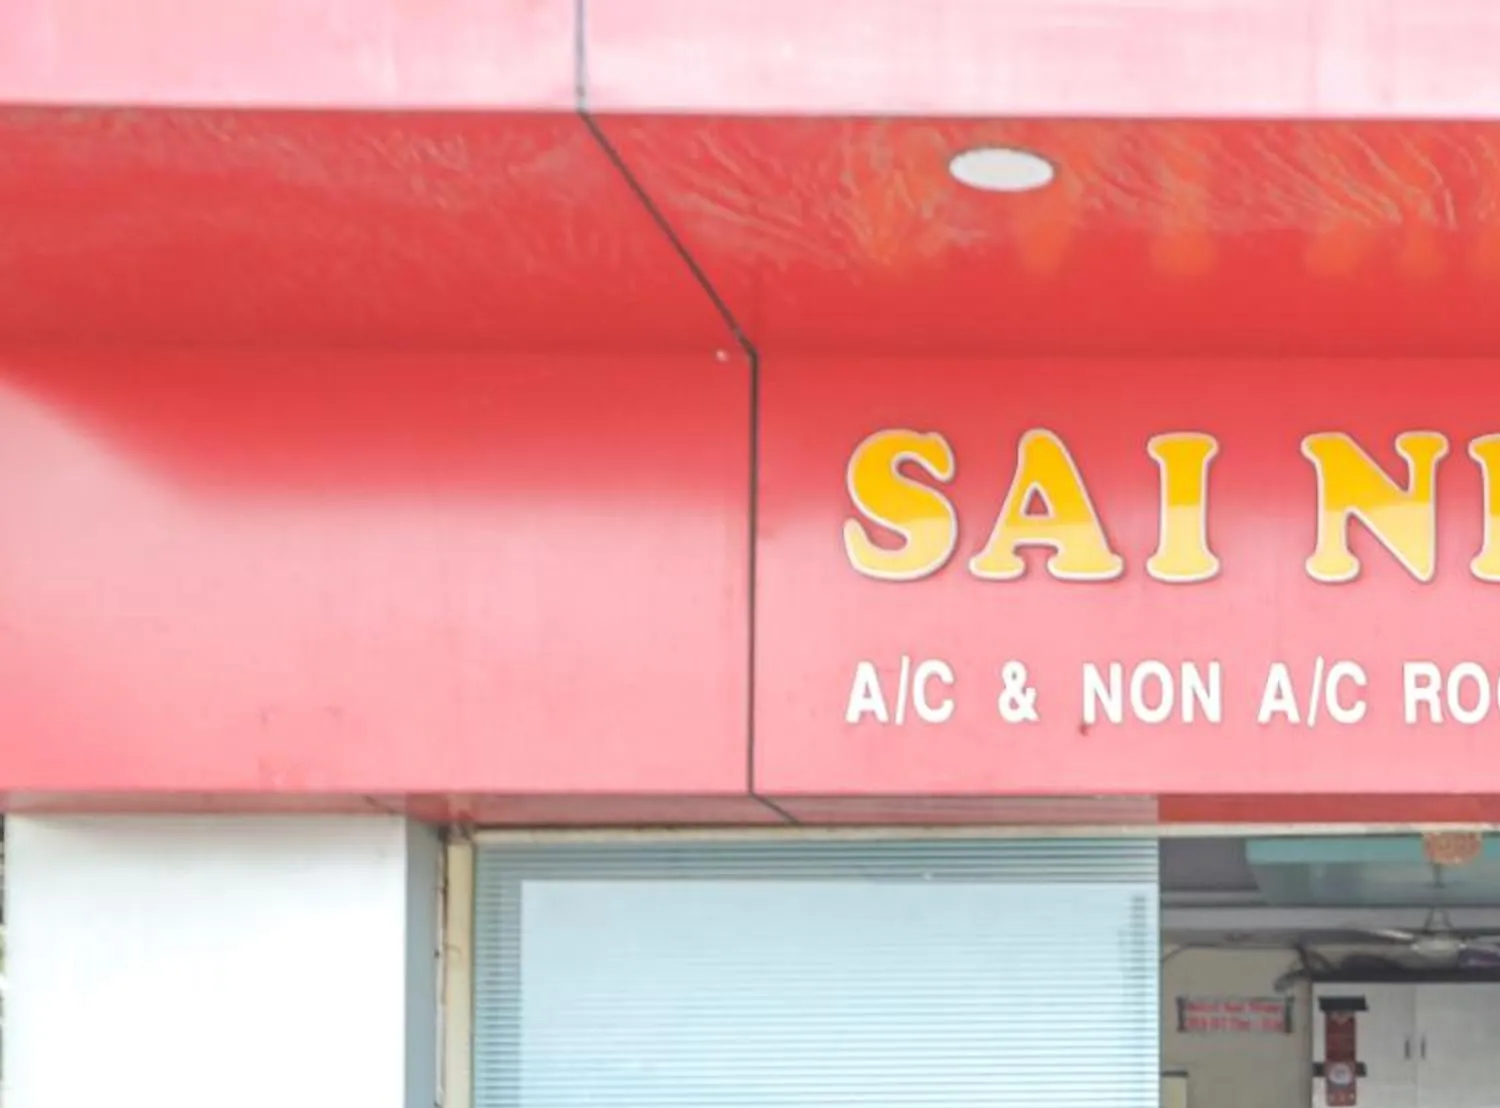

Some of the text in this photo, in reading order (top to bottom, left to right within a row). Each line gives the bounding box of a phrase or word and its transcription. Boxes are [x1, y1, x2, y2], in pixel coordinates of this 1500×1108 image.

[842, 428, 1221, 581] SAI
[845, 655, 954, 724] A/C
[998, 659, 1038, 723] &
[1082, 660, 1221, 723] NON
[1257, 655, 1368, 726] A/C
